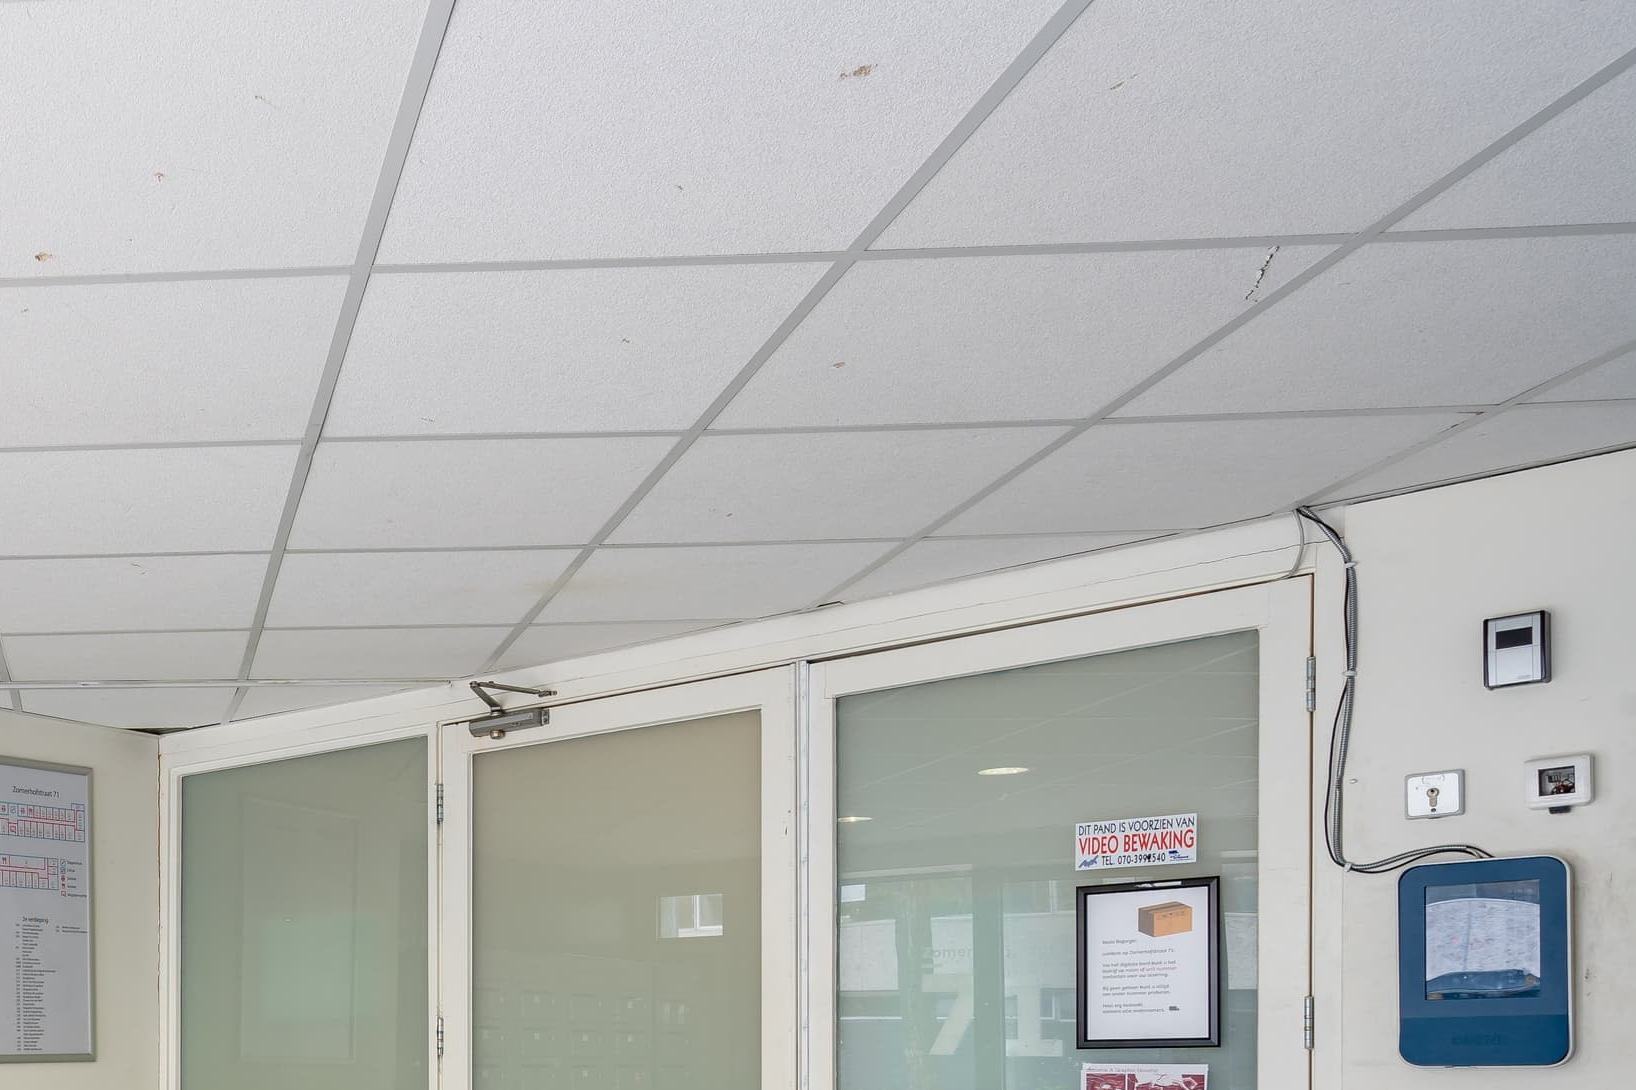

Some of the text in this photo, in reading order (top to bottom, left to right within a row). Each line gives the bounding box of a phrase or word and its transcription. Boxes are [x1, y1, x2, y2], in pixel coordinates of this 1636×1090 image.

[1078, 816, 1195, 836] DIT PAND IS VOORZIEN VAN
[1079, 828, 1195, 855] VIDEO BEWAKING
